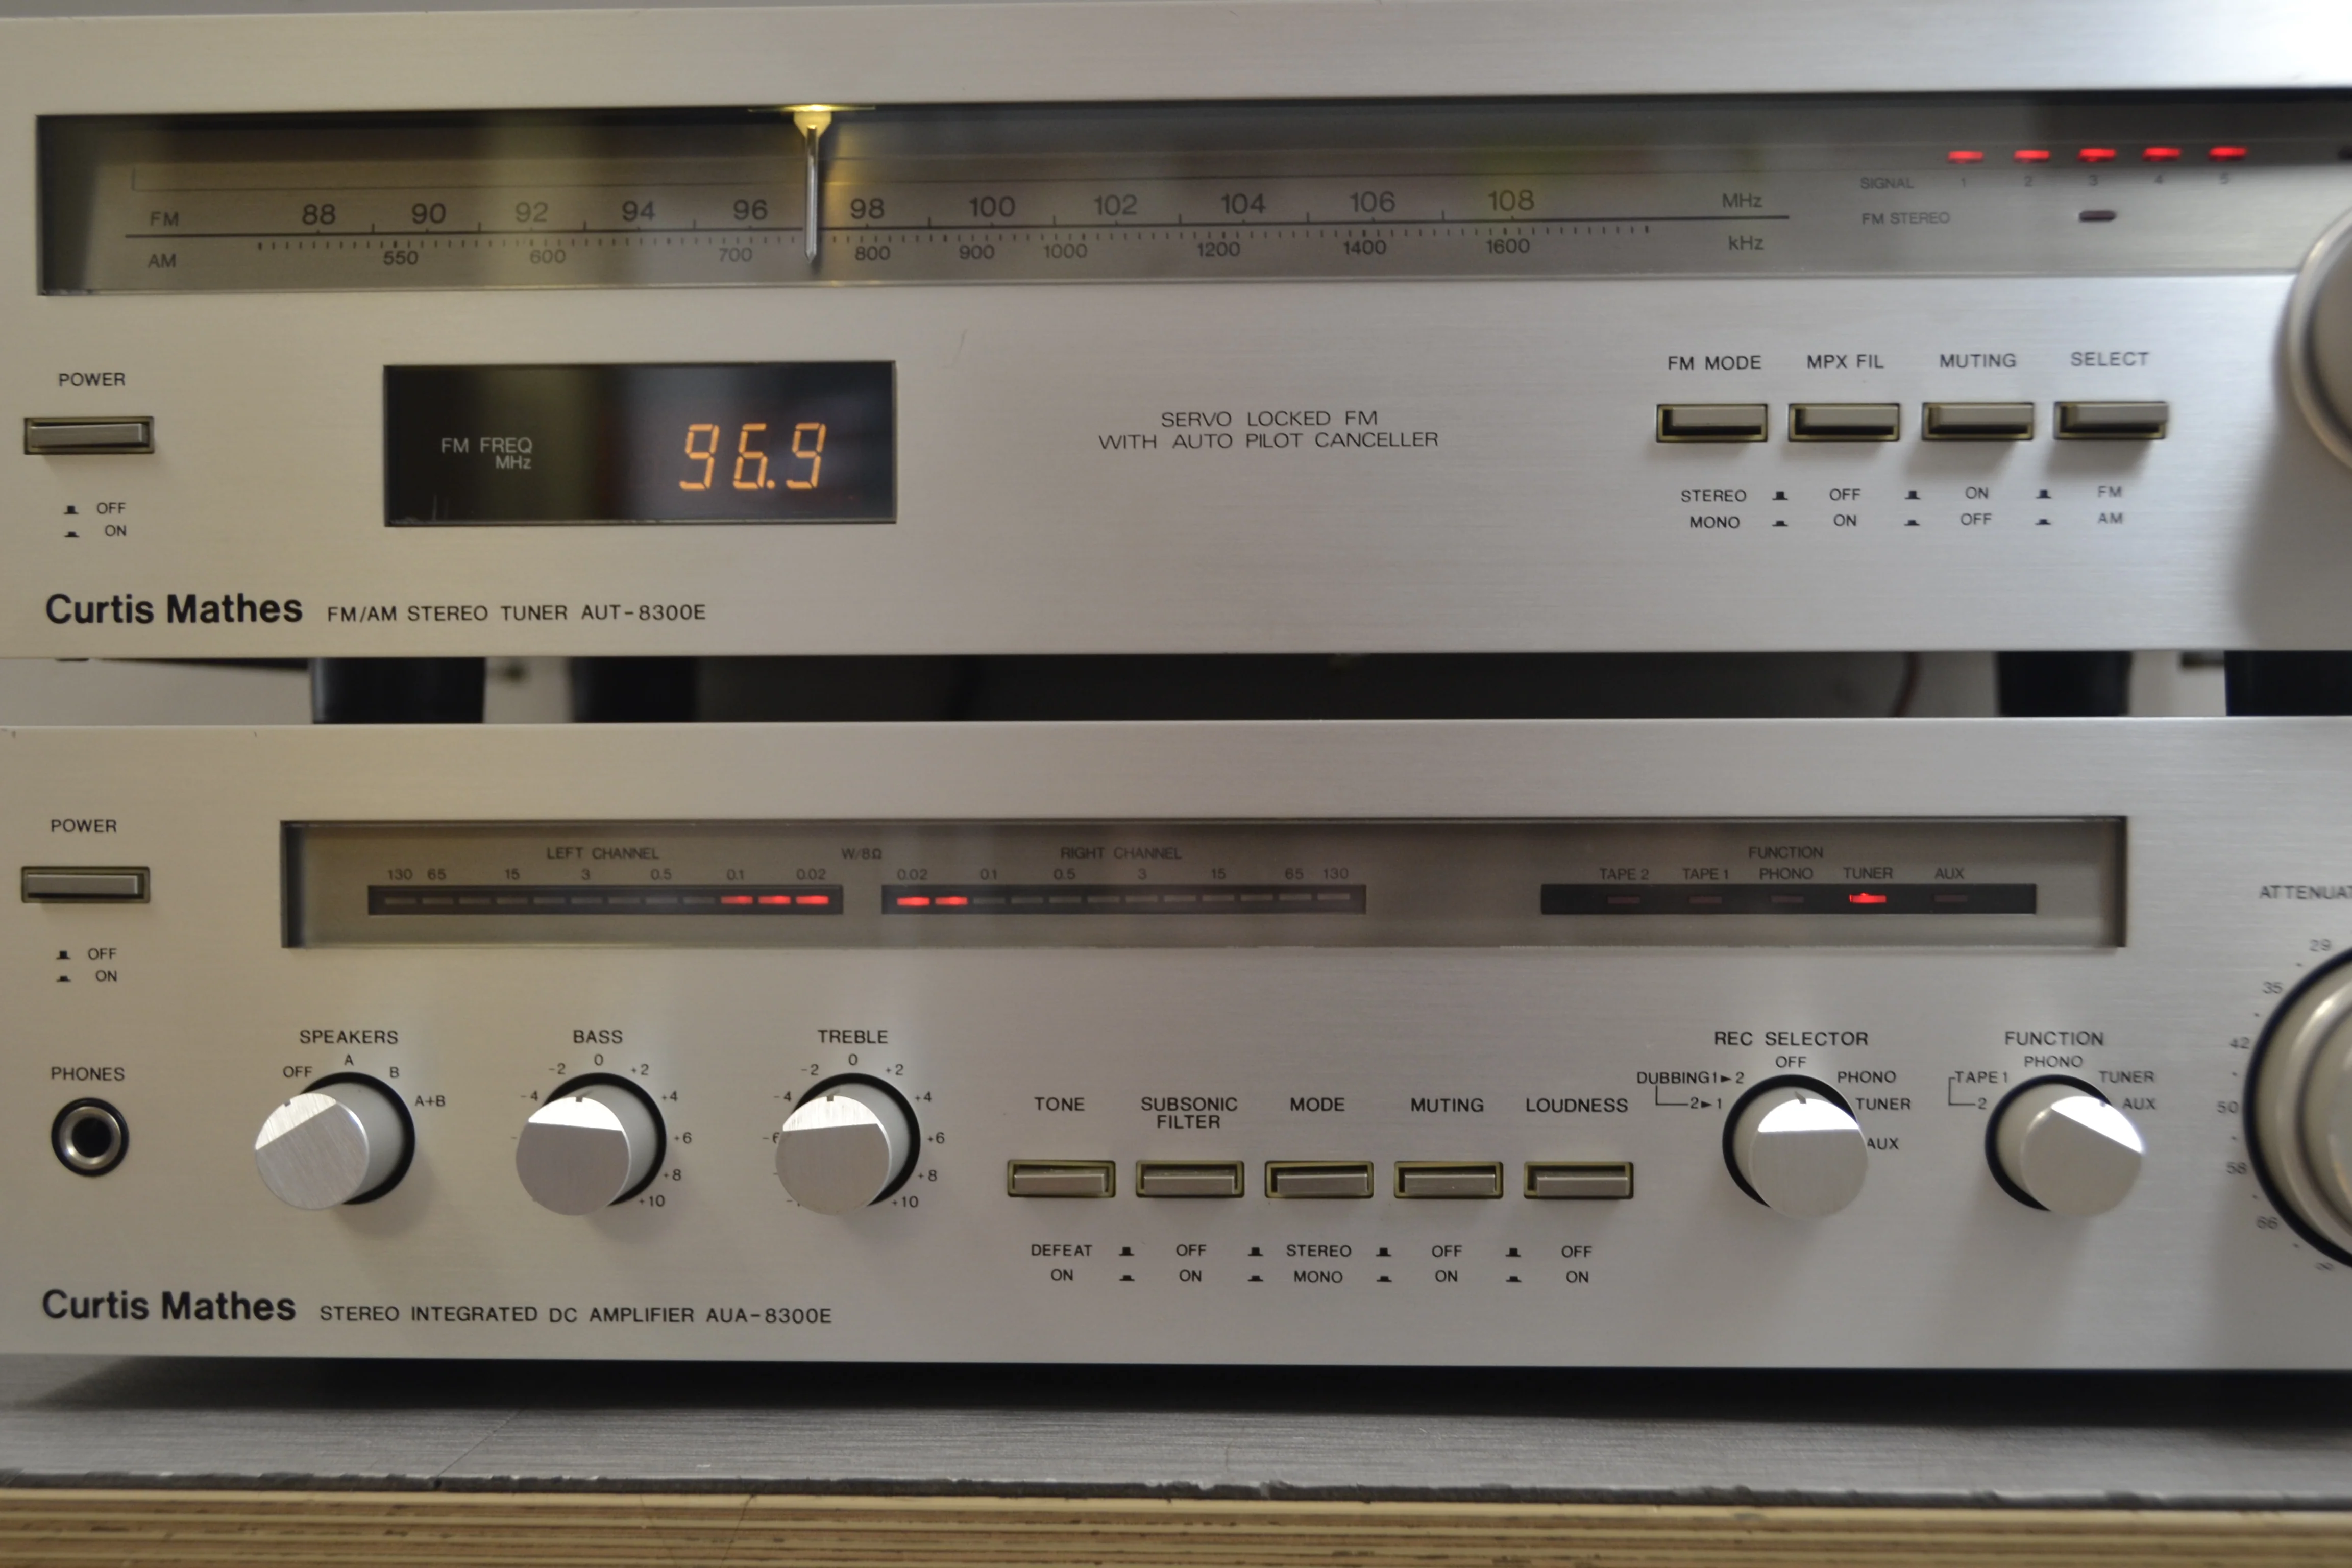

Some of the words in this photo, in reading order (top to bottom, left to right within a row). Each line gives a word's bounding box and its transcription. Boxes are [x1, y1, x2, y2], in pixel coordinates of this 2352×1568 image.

[1860, 177, 1914, 189] SIGNAL
[1961, 177, 1966, 188] 1
[2024, 175, 2033, 187] 2
[2088, 174, 2099, 186] 3
[2153, 174, 2164, 185] 4
[2219, 173, 2230, 185] 5
[151, 211, 180, 227] FM
[302, 203, 336, 226] 88
[411, 202, 447, 225] 90
[515, 201, 549, 223] 92
[621, 201, 656, 222] 94
[733, 198, 768, 220] 96
[850, 197, 886, 220] 98
[968, 196, 1016, 218] 100
[1093, 193, 1138, 216] 102
[1221, 193, 1266, 215] 104
[1350, 191, 1396, 213] 106
[1487, 188, 1535, 212] 108
[1722, 192, 1762, 208] MHz
[1861, 212, 1884, 225] FM
[1889, 211, 1950, 226] STEREO
[148, 253, 177, 268] AM
[383, 250, 419, 266] 550
[529, 249, 567, 264] 600
[719, 246, 754, 263] 700
[854, 244, 891, 261] 800
[959, 244, 995, 260] 900
[1043, 242, 1088, 259] 1000
[1197, 241, 1241, 258] 1200
[1343, 239, 1387, 256] 1400
[1486, 238, 1531, 255] 1600
[1728, 235, 1764, 251] kHz
[1668, 356, 1695, 371] FM
[1705, 355, 1761, 371] MODE
[1807, 354, 1847, 369] MPX
[1856, 353, 1884, 369] FIL
[1940, 353, 2017, 369] MUTING
[2070, 351, 2149, 367] SELECT
[58, 372, 126, 387] POWER
[1161, 411, 1232, 428] SERVO
[1247, 410, 1331, 427] LOCKED
[1345, 410, 1378, 426] FM
[441, 437, 469, 453] FM
[480, 436, 533, 454] FREQ
[1098, 434, 1157, 450] WITH
[1172, 433, 1233, 449] AUTO
[1245, 432, 1304, 449] PILOT
[1314, 431, 1438, 448] CANCELLER
[495, 455, 531, 470] MHz
[678, 423, 826, 492] 96.9
[1681, 489, 1747, 503] STEREO
[1829, 487, 1861, 502] OFF
[1965, 486, 1989, 500] ON
[2097, 484, 2123, 498] FM
[96, 502, 126, 515] OFF
[1689, 516, 1741, 529] MONO
[1833, 513, 1857, 527] ON
[1960, 512, 1992, 526] OFF
[2098, 512, 2123, 524] AM
[104, 524, 127, 537] ON
[45, 593, 155, 625] Curtis
[167, 592, 303, 624] Mathes
[328, 605, 397, 623] FM/AM
[407, 605, 488, 622] STEREO
[500, 604, 568, 622] TUNER
[581, 603, 706, 621] AUT-8300E
[51, 818, 117, 834] POWER
[546, 846, 584, 860] LEFT
[591, 846, 659, 861] CHANNEL
[1060, 846, 1105, 860] RIGHT
[1113, 846, 1183, 860] CHANNEL
[1748, 845, 1824, 859] FUNCTION
[387, 868, 413, 881] 130
[427, 868, 447, 881] 65
[505, 868, 521, 881] 15
[581, 868, 591, 881] 3
[1138, 867, 1148, 881] 3
[1211, 867, 1227, 880] 15
[1284, 867, 1304, 880] 65
[1323, 867, 1350, 880] 130
[1599, 867, 1636, 881] TAPE
[1640, 868, 1650, 881] 2
[1682, 867, 1719, 881] TAPE
[1723, 868, 1729, 880] 1
[1759, 867, 1814, 880] PHONO
[1843, 866, 1894, 880] TUNER
[1934, 867, 1965, 880] AUX
[2309, 938, 2333, 952] 29
[87, 947, 117, 961] OFF
[95, 969, 117, 983] ON
[2262, 981, 2284, 994] 35
[299, 1029, 399, 1045] SPEAKERS
[573, 1029, 623, 1044] BASS
[817, 1029, 888, 1044] TREBLE
[1714, 1031, 1753, 1046] REC
[1765, 1031, 1869, 1047] SELECTOR
[2005, 1030, 2105, 1047] FUNCTION
[2229, 1036, 2250, 1050] 42
[344, 1054, 354, 1066] A
[593, 1053, 604, 1066] 0
[848, 1053, 859, 1066] 0
[1775, 1055, 1806, 1069] OFF
[2024, 1055, 2085, 1069] PHONO
[51, 1066, 125, 1082] PHONES
[282, 1065, 312, 1079] OFF
[389, 1066, 400, 1079] B
[1636, 1071, 1709, 1084] DUBBING
[1837, 1070, 1897, 1084] PHONO
[1955, 1071, 1998, 1084] TAPE
[2002, 1071, 2008, 1083] 1
[2099, 1070, 2154, 1084] TUNER
[414, 1094, 446, 1108] A+B
[1034, 1096, 1085, 1112] TONE
[1141, 1096, 1238, 1112] SUBSONIC
[1290, 1097, 1345, 1112] MODE
[1411, 1097, 1484, 1113] MUTING
[1526, 1097, 1628, 1113] LOUDNESS
[1855, 1097, 1911, 1111] TUNER
[1977, 1097, 1988, 1111] 2
[2122, 1097, 2156, 1111] AUX
[2216, 1100, 2239, 1114] 50
[1157, 1114, 1220, 1130] FILTER
[1867, 1137, 1899, 1150] AUX
[1031, 1243, 1093, 1257] DEFEAT
[1175, 1243, 1207, 1257] OFF
[1286, 1243, 1352, 1258] STEREO
[1431, 1244, 1462, 1258] OFF
[1561, 1245, 1592, 1258] OFF
[1050, 1268, 1073, 1282] ON
[1179, 1269, 1202, 1282] ON
[1293, 1270, 1343, 1284] MONO
[1434, 1269, 1458, 1283] ON
[1565, 1270, 1589, 1284] ON
[42, 1288, 150, 1321] Curtis
[161, 1290, 296, 1321] Mathes
[320, 1305, 400, 1322] STEREO
[411, 1306, 538, 1322] INTEGRATED
[549, 1307, 578, 1324] DC
[589, 1307, 694, 1323] AMPLIFIER
[706, 1307, 831, 1325] AUA-8300E
